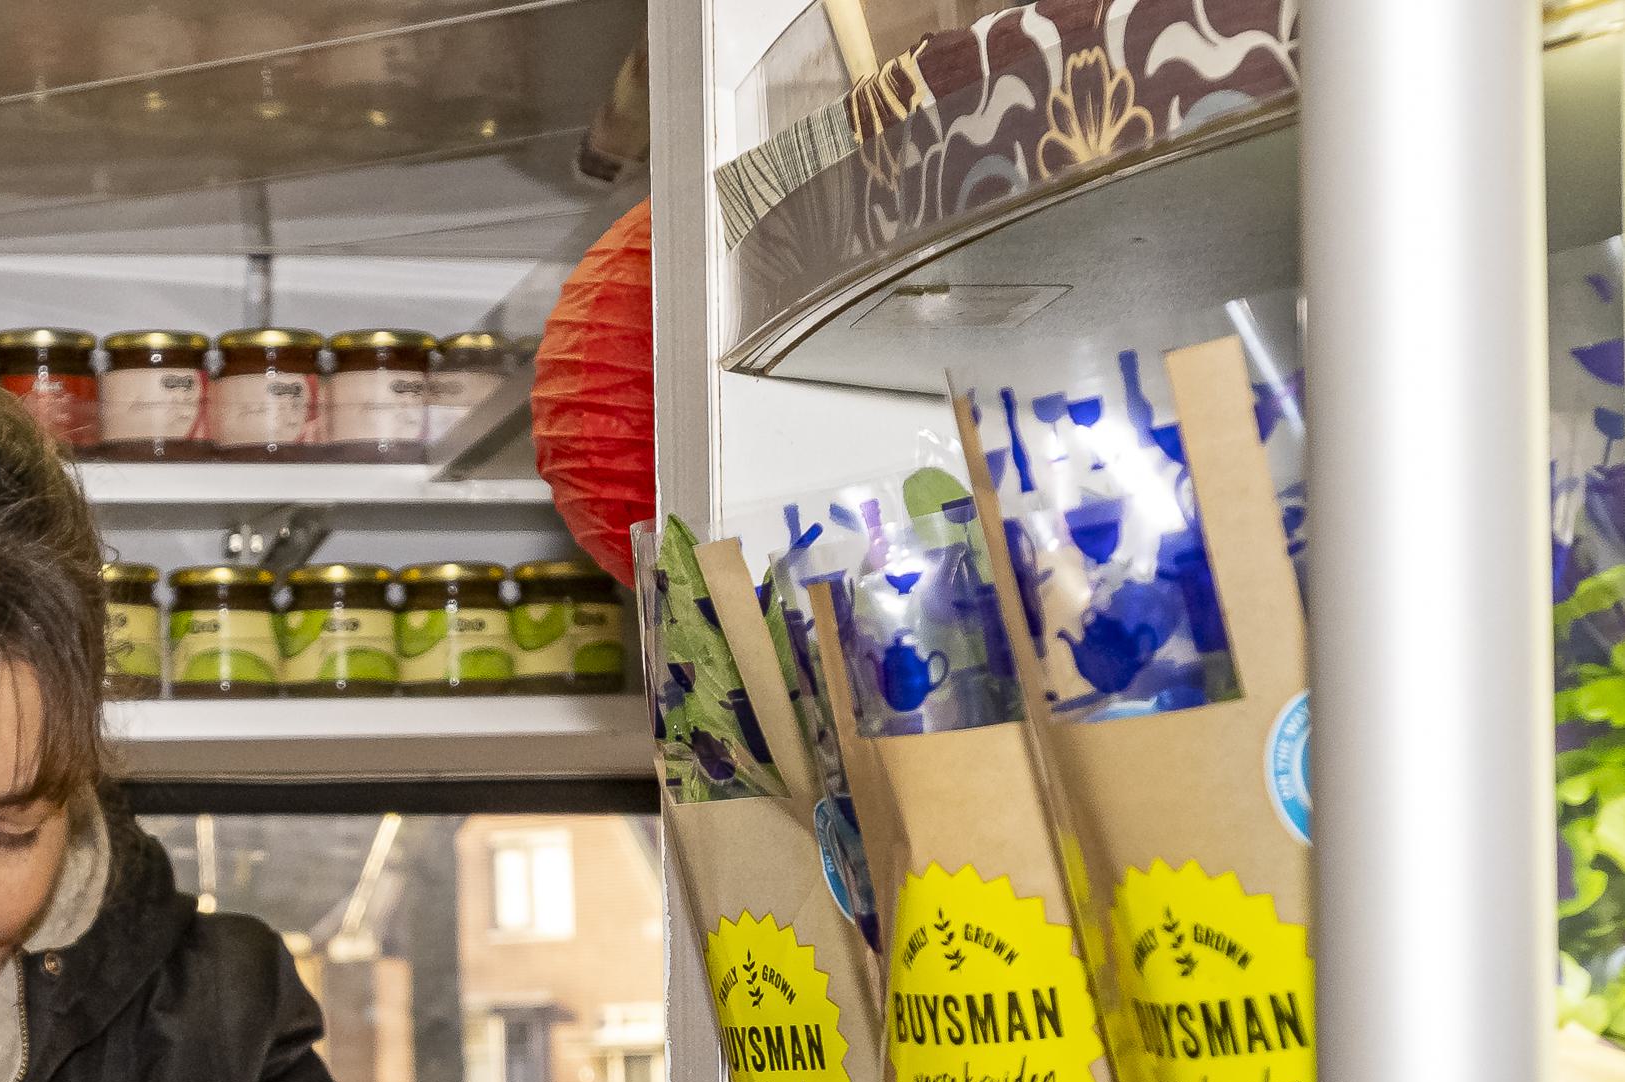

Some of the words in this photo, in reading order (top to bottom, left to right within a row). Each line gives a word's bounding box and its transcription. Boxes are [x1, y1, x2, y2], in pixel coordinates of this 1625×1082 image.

[902, 926, 929, 971] FAMILY
[964, 923, 1018, 966] GROWN
[718, 966, 739, 1008] FAMILY
[762, 964, 797, 1005] GROWN
[894, 986, 1064, 1046] BUYSMAN
[725, 1023, 826, 1072] UYSMAN
